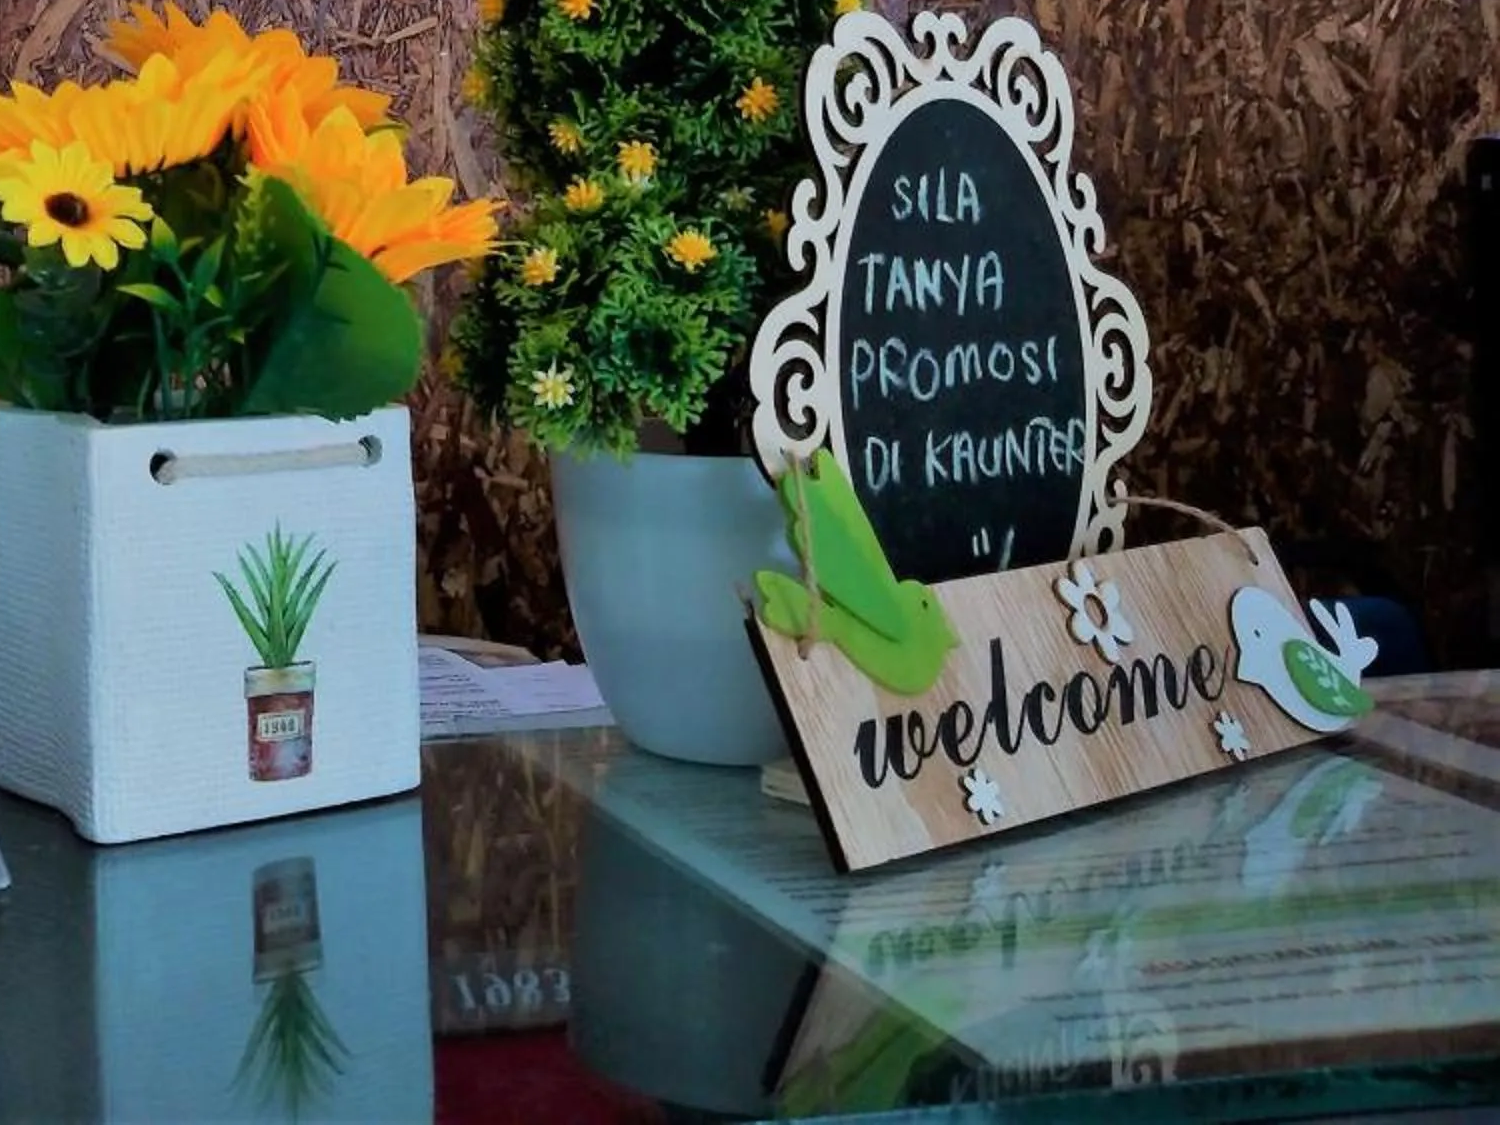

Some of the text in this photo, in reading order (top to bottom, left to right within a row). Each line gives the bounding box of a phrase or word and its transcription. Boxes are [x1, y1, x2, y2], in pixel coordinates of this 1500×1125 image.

[890, 166, 982, 224] SILA
[856, 251, 1004, 316] TANYA
[850, 335, 1059, 411] PROMOSI
[863, 417, 1086, 492] DI KAUNTER
[853, 636, 1231, 789] welcome
